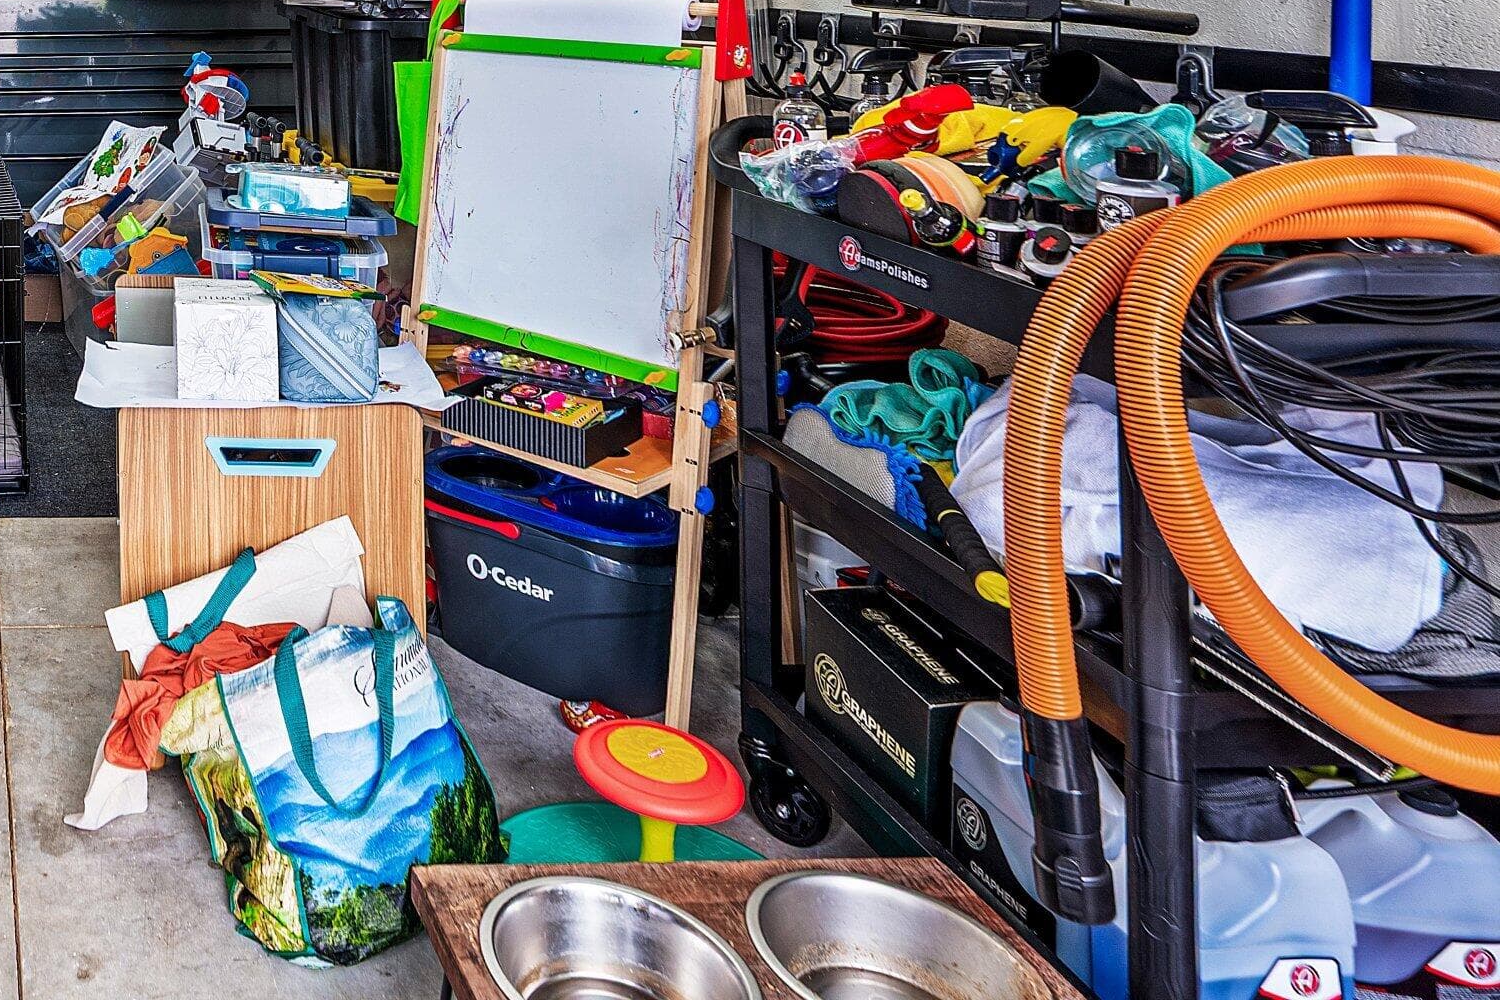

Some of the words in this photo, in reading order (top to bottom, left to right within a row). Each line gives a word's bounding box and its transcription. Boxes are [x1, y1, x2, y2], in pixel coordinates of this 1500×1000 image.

[884, 623, 960, 685] GRAPHENE
[841, 690, 916, 771] GRAPHENE
[969, 860, 1028, 921] GRAPHENE
